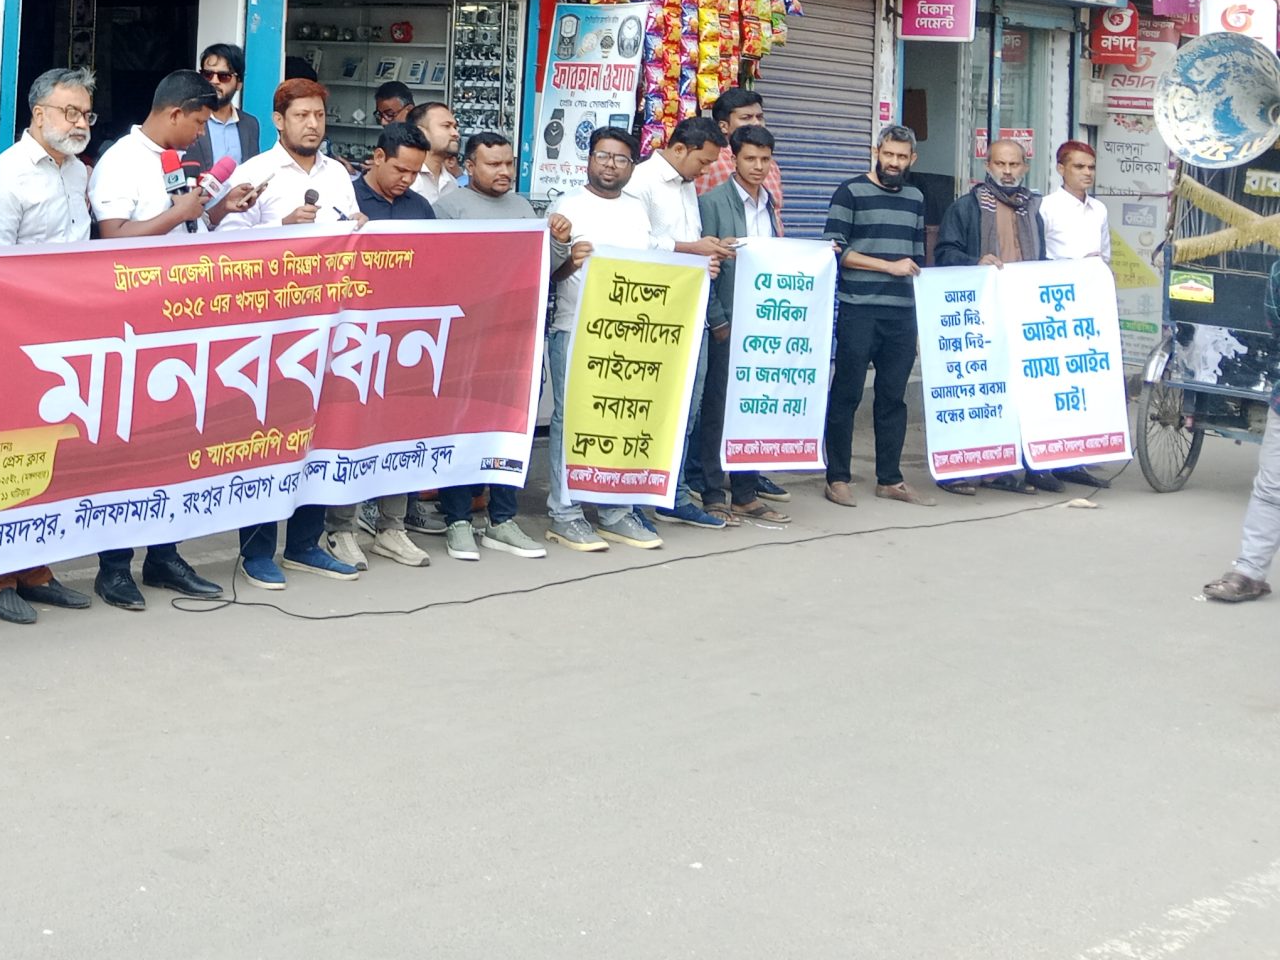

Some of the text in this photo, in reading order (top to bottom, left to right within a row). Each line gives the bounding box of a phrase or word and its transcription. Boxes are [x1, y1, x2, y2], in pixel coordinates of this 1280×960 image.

[917, 0, 955, 15] বিকাশ
[915, 17, 955, 30] পেমেন্ট
[1101, 35, 1136, 51] নগদ
[1111, 74, 1157, 89] নগদ
[1104, 141, 1144, 156] আলপনা
[1120, 157, 1161, 174] টেলিকম
[114, 249, 415, 292] ট্রাভেল এজেন্সী নিবন্ধন ও অধ্যাদেশ
[754, 271, 815, 292] যে আইন
[609, 272, 670, 306] ট্রাভেল
[945, 290, 975, 303] আমরা
[1039, 283, 1075, 313] নতুন
[161, 280, 322, 321] ২০২৫ এর খসড়া বাতিলের
[756, 299, 808, 322] জীবিকা
[587, 314, 684, 345] এজেন্সীদের
[941, 314, 961, 327] ভ্যাট
[1023, 316, 1067, 342] আইন
[742, 335, 782, 354] কেড়ে
[20, 304, 467, 445] মানববন্ধন
[587, 352, 663, 383] লাইসেন্স
[947, 360, 987, 379] তবু কেন
[1022, 348, 1110, 379] ন্যায্য আইন
[736, 367, 816, 385] তা জনগণের
[931, 382, 1006, 399] আমাদের ব্যবসা
[1054, 386, 1087, 412] চাই!
[592, 395, 653, 421] নবায়ন
[739, 395, 778, 415] আইন
[188, 426, 316, 470] ও স্মারকলিপি প্রদা
[572, 431, 653, 459] দ্রুত চাই
[2, 454, 24, 469] প্রেস
[26, 451, 47, 467] ক্লাব
[74, 488, 174, 533] নীলফামারী,
[183, 485, 224, 514] রংপুর
[229, 475, 275, 505] বিভাগ
[278, 470, 301, 495] এর
[332, 454, 379, 485] ট্রাভেল
[381, 441, 428, 472] এজেন্সী
[430, 445, 455, 475] বৃন্দ
